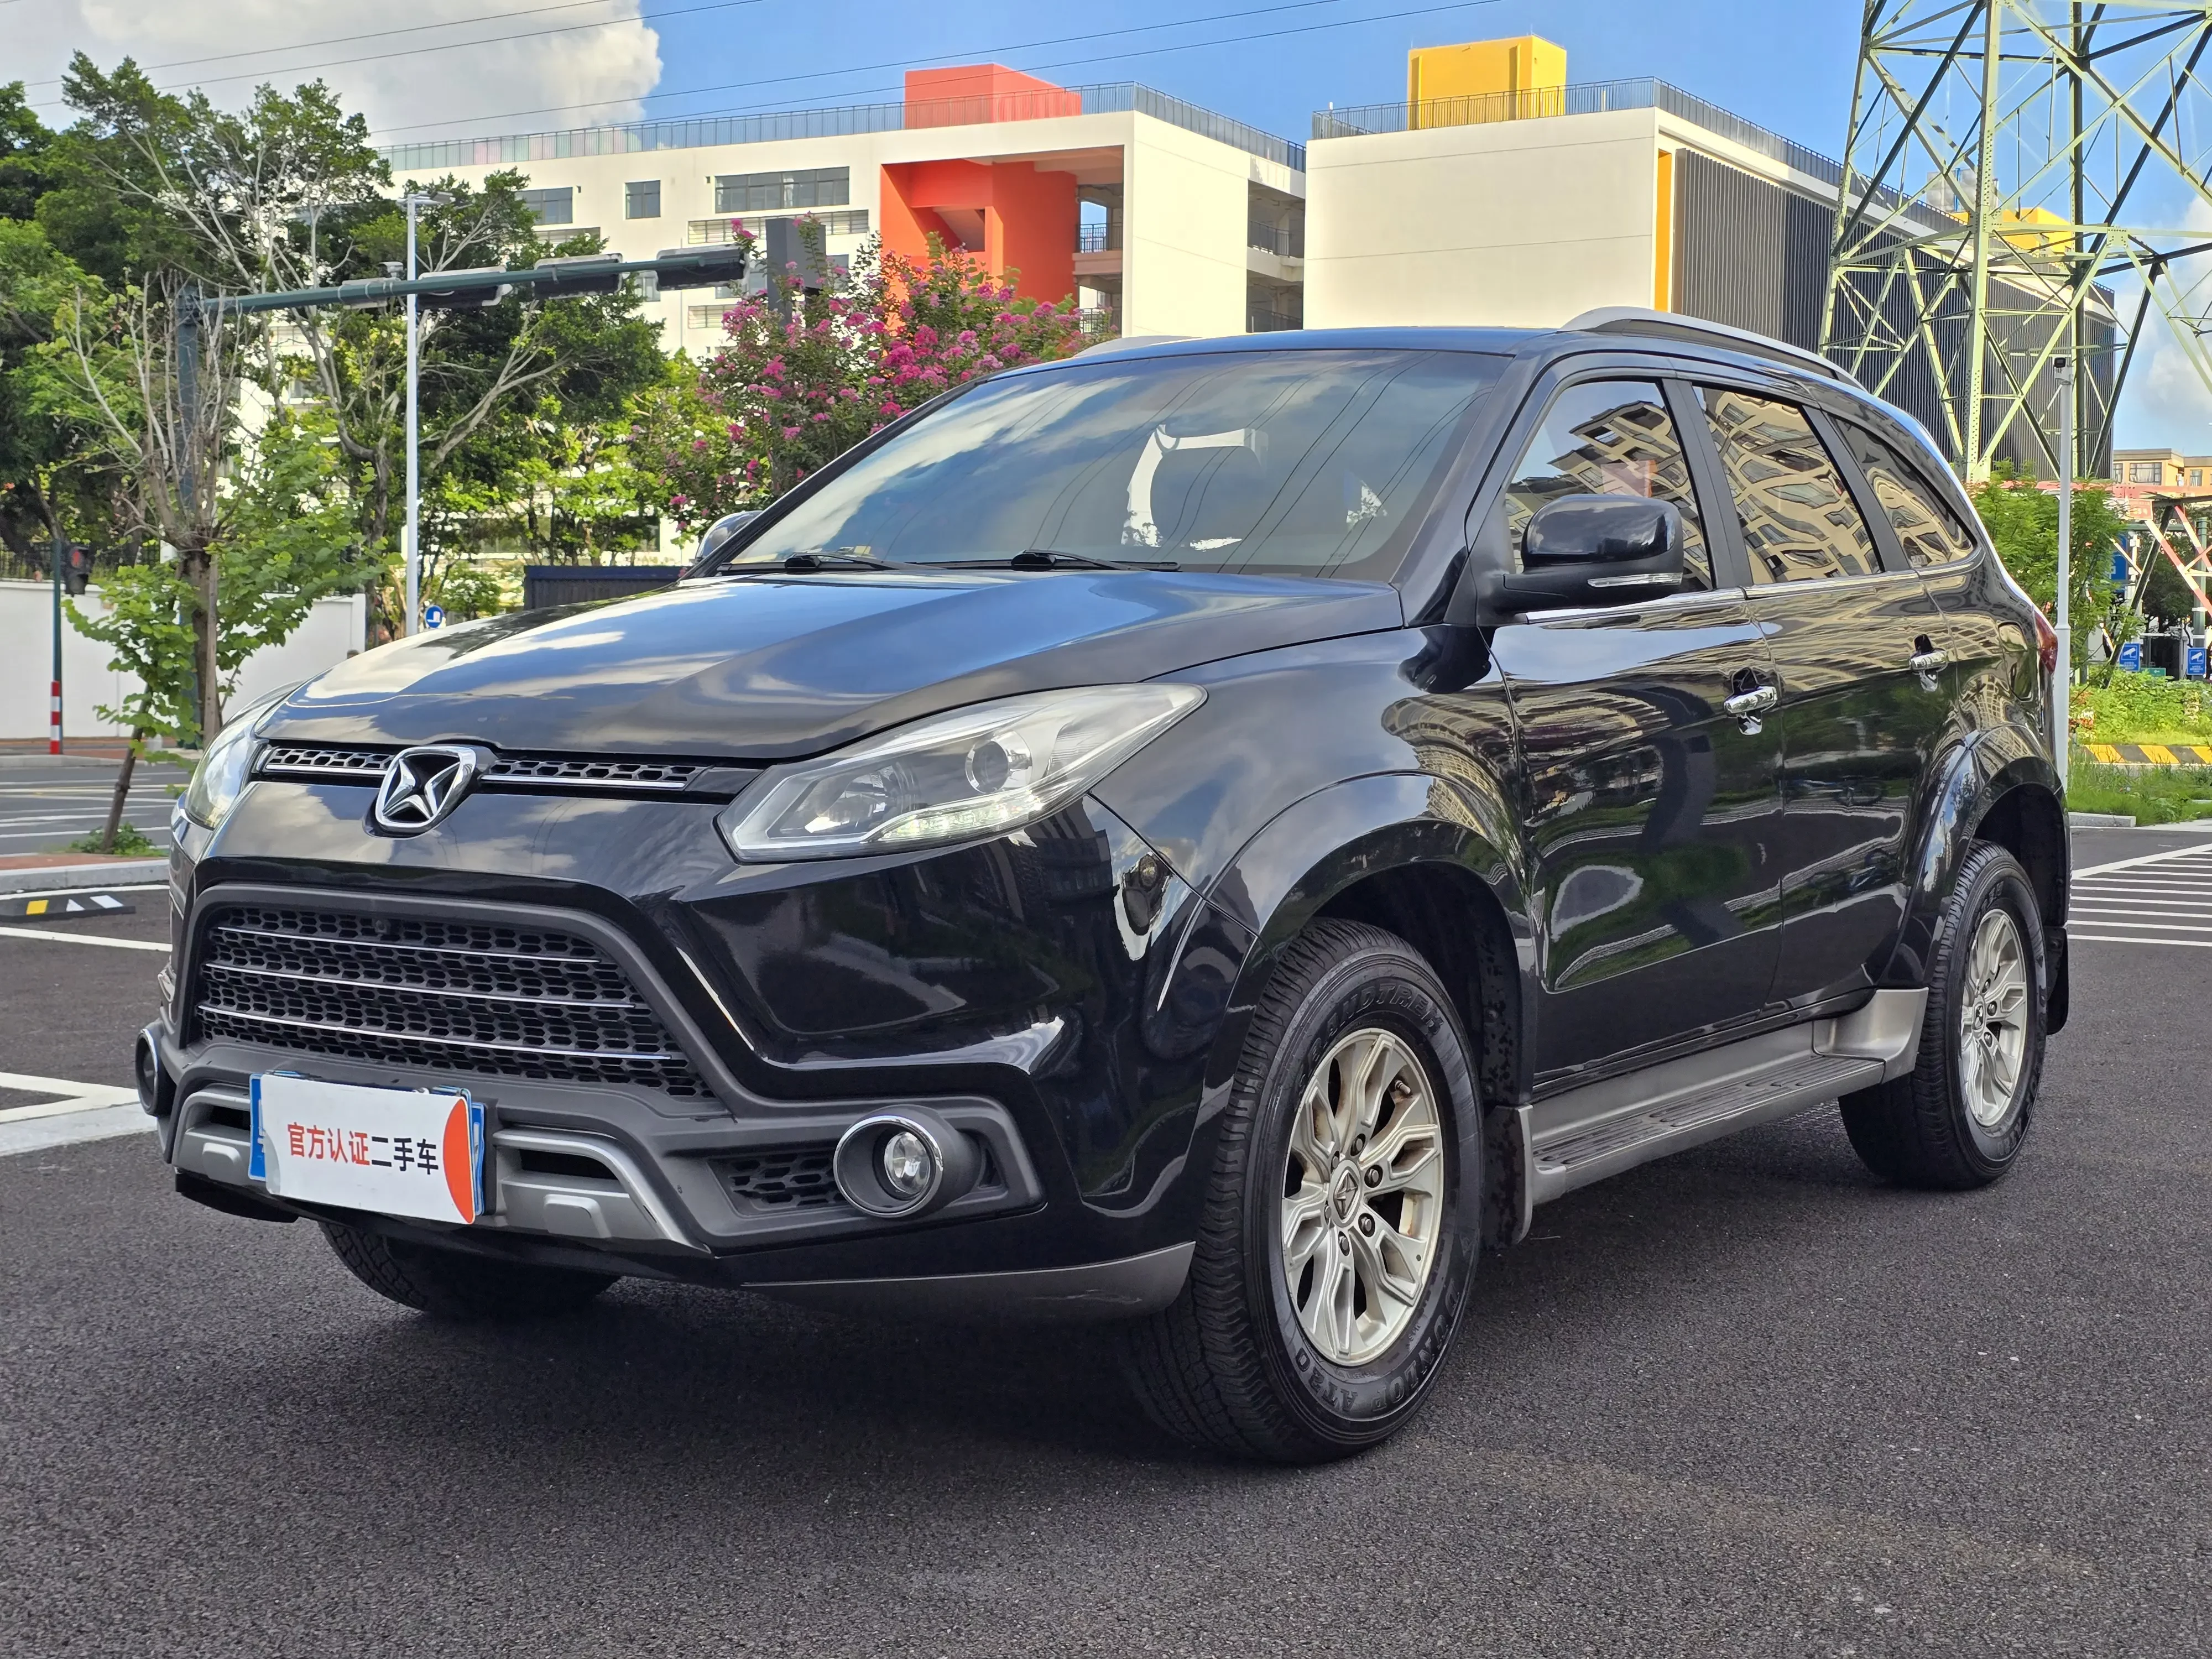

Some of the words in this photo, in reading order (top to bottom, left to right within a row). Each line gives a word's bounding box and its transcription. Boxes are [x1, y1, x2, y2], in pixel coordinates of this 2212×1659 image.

[287, 1121, 439, 1175] 官方认证二手车
[1295, 1347, 1358, 1412] AT20
